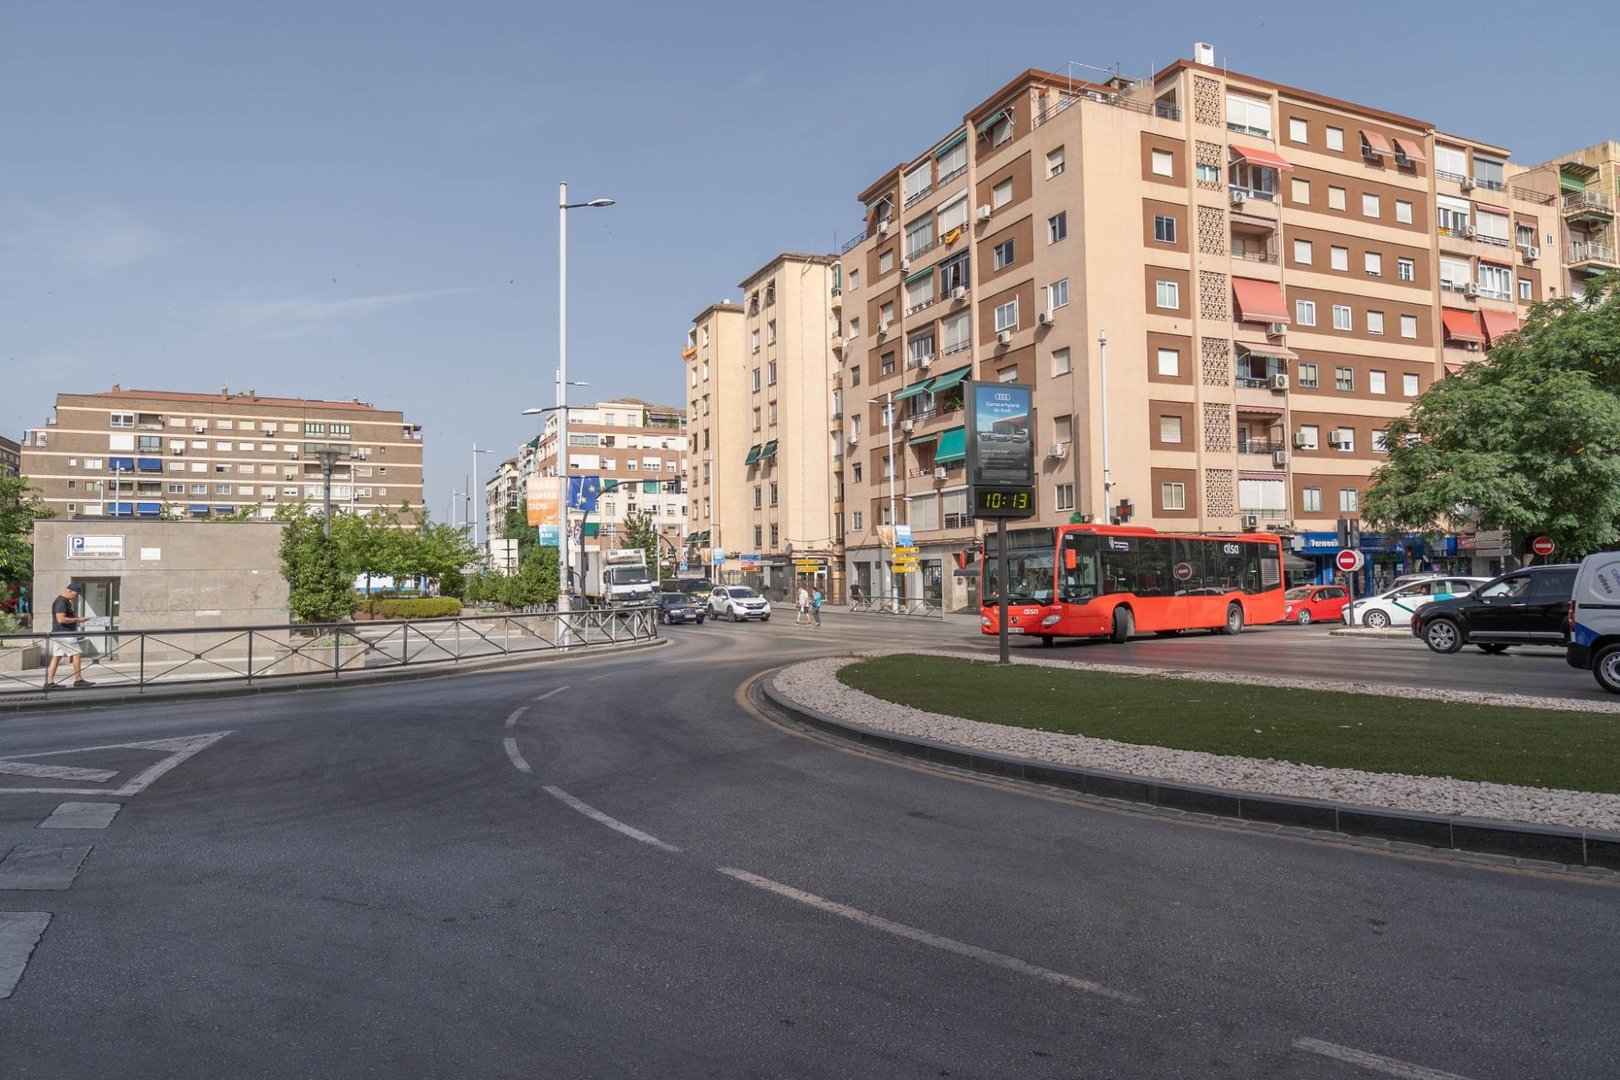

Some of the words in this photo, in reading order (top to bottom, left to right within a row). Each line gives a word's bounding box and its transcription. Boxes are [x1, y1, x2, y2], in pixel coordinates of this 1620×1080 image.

[986, 493, 1028, 509] 10:13
[74, 538, 83, 548] P
[1223, 543, 1240, 554] alsa
[1598, 574, 1613, 594] edesa
